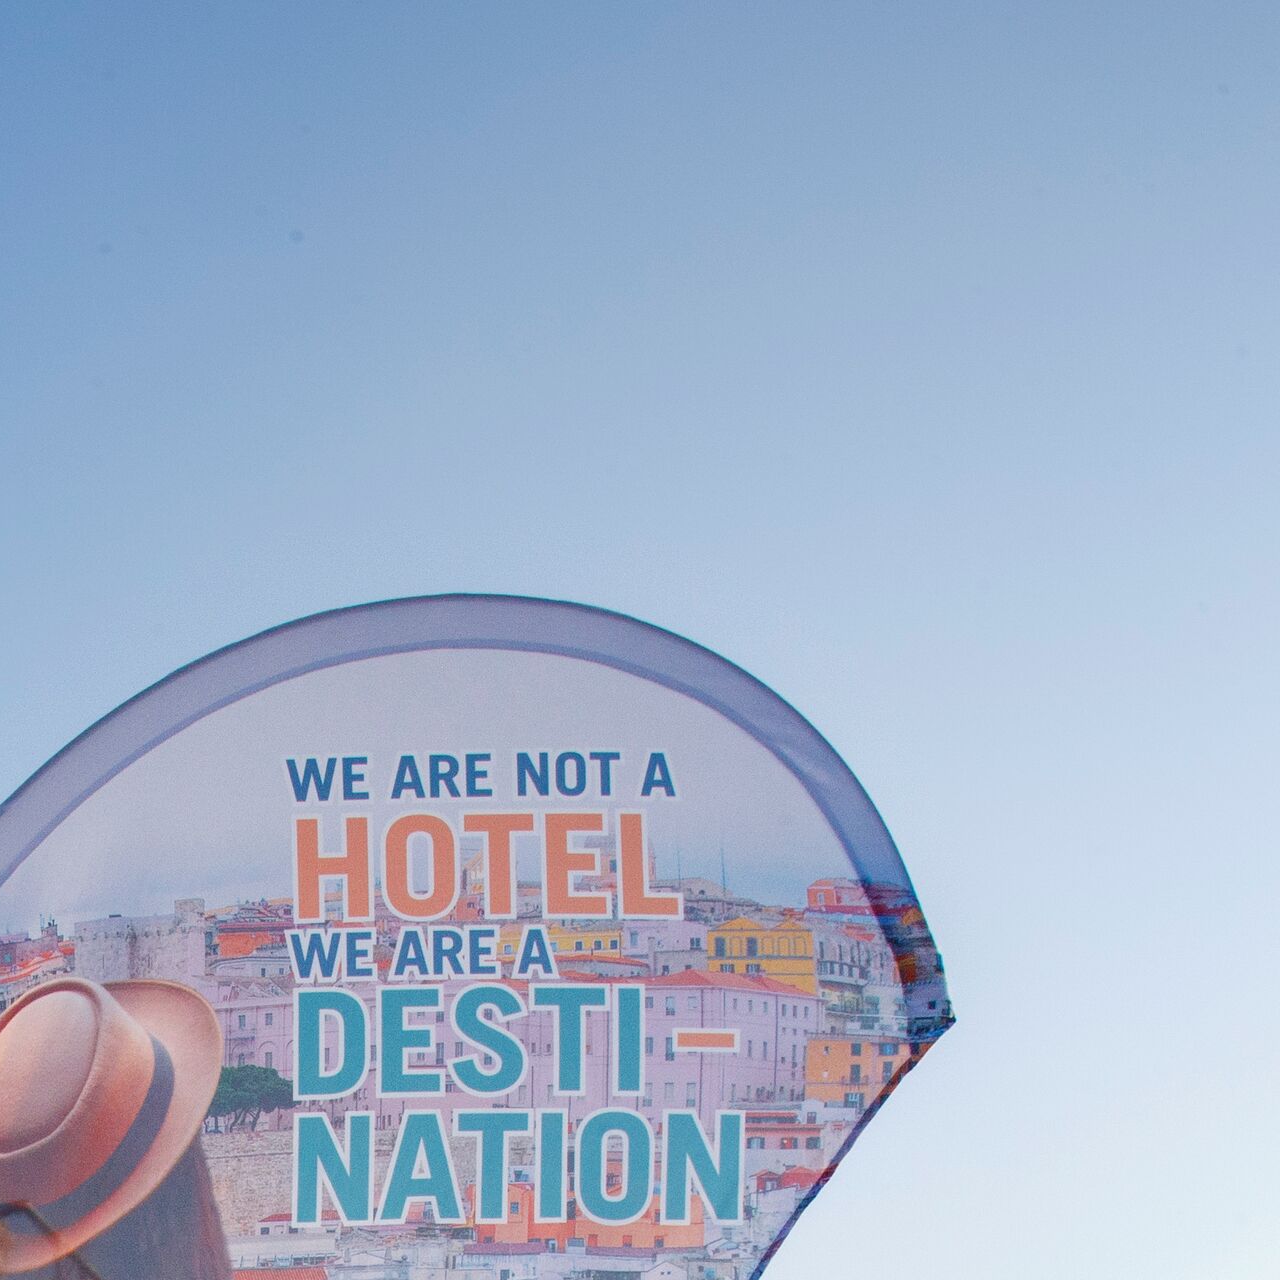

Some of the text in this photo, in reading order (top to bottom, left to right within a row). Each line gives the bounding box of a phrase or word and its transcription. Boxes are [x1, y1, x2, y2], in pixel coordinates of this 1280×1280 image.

[286, 752, 676, 802] WE ARE NOT A
[295, 812, 682, 920] HOTEL
[290, 928, 557, 979] WE ARE A
[296, 1110, 743, 1225] NATION
